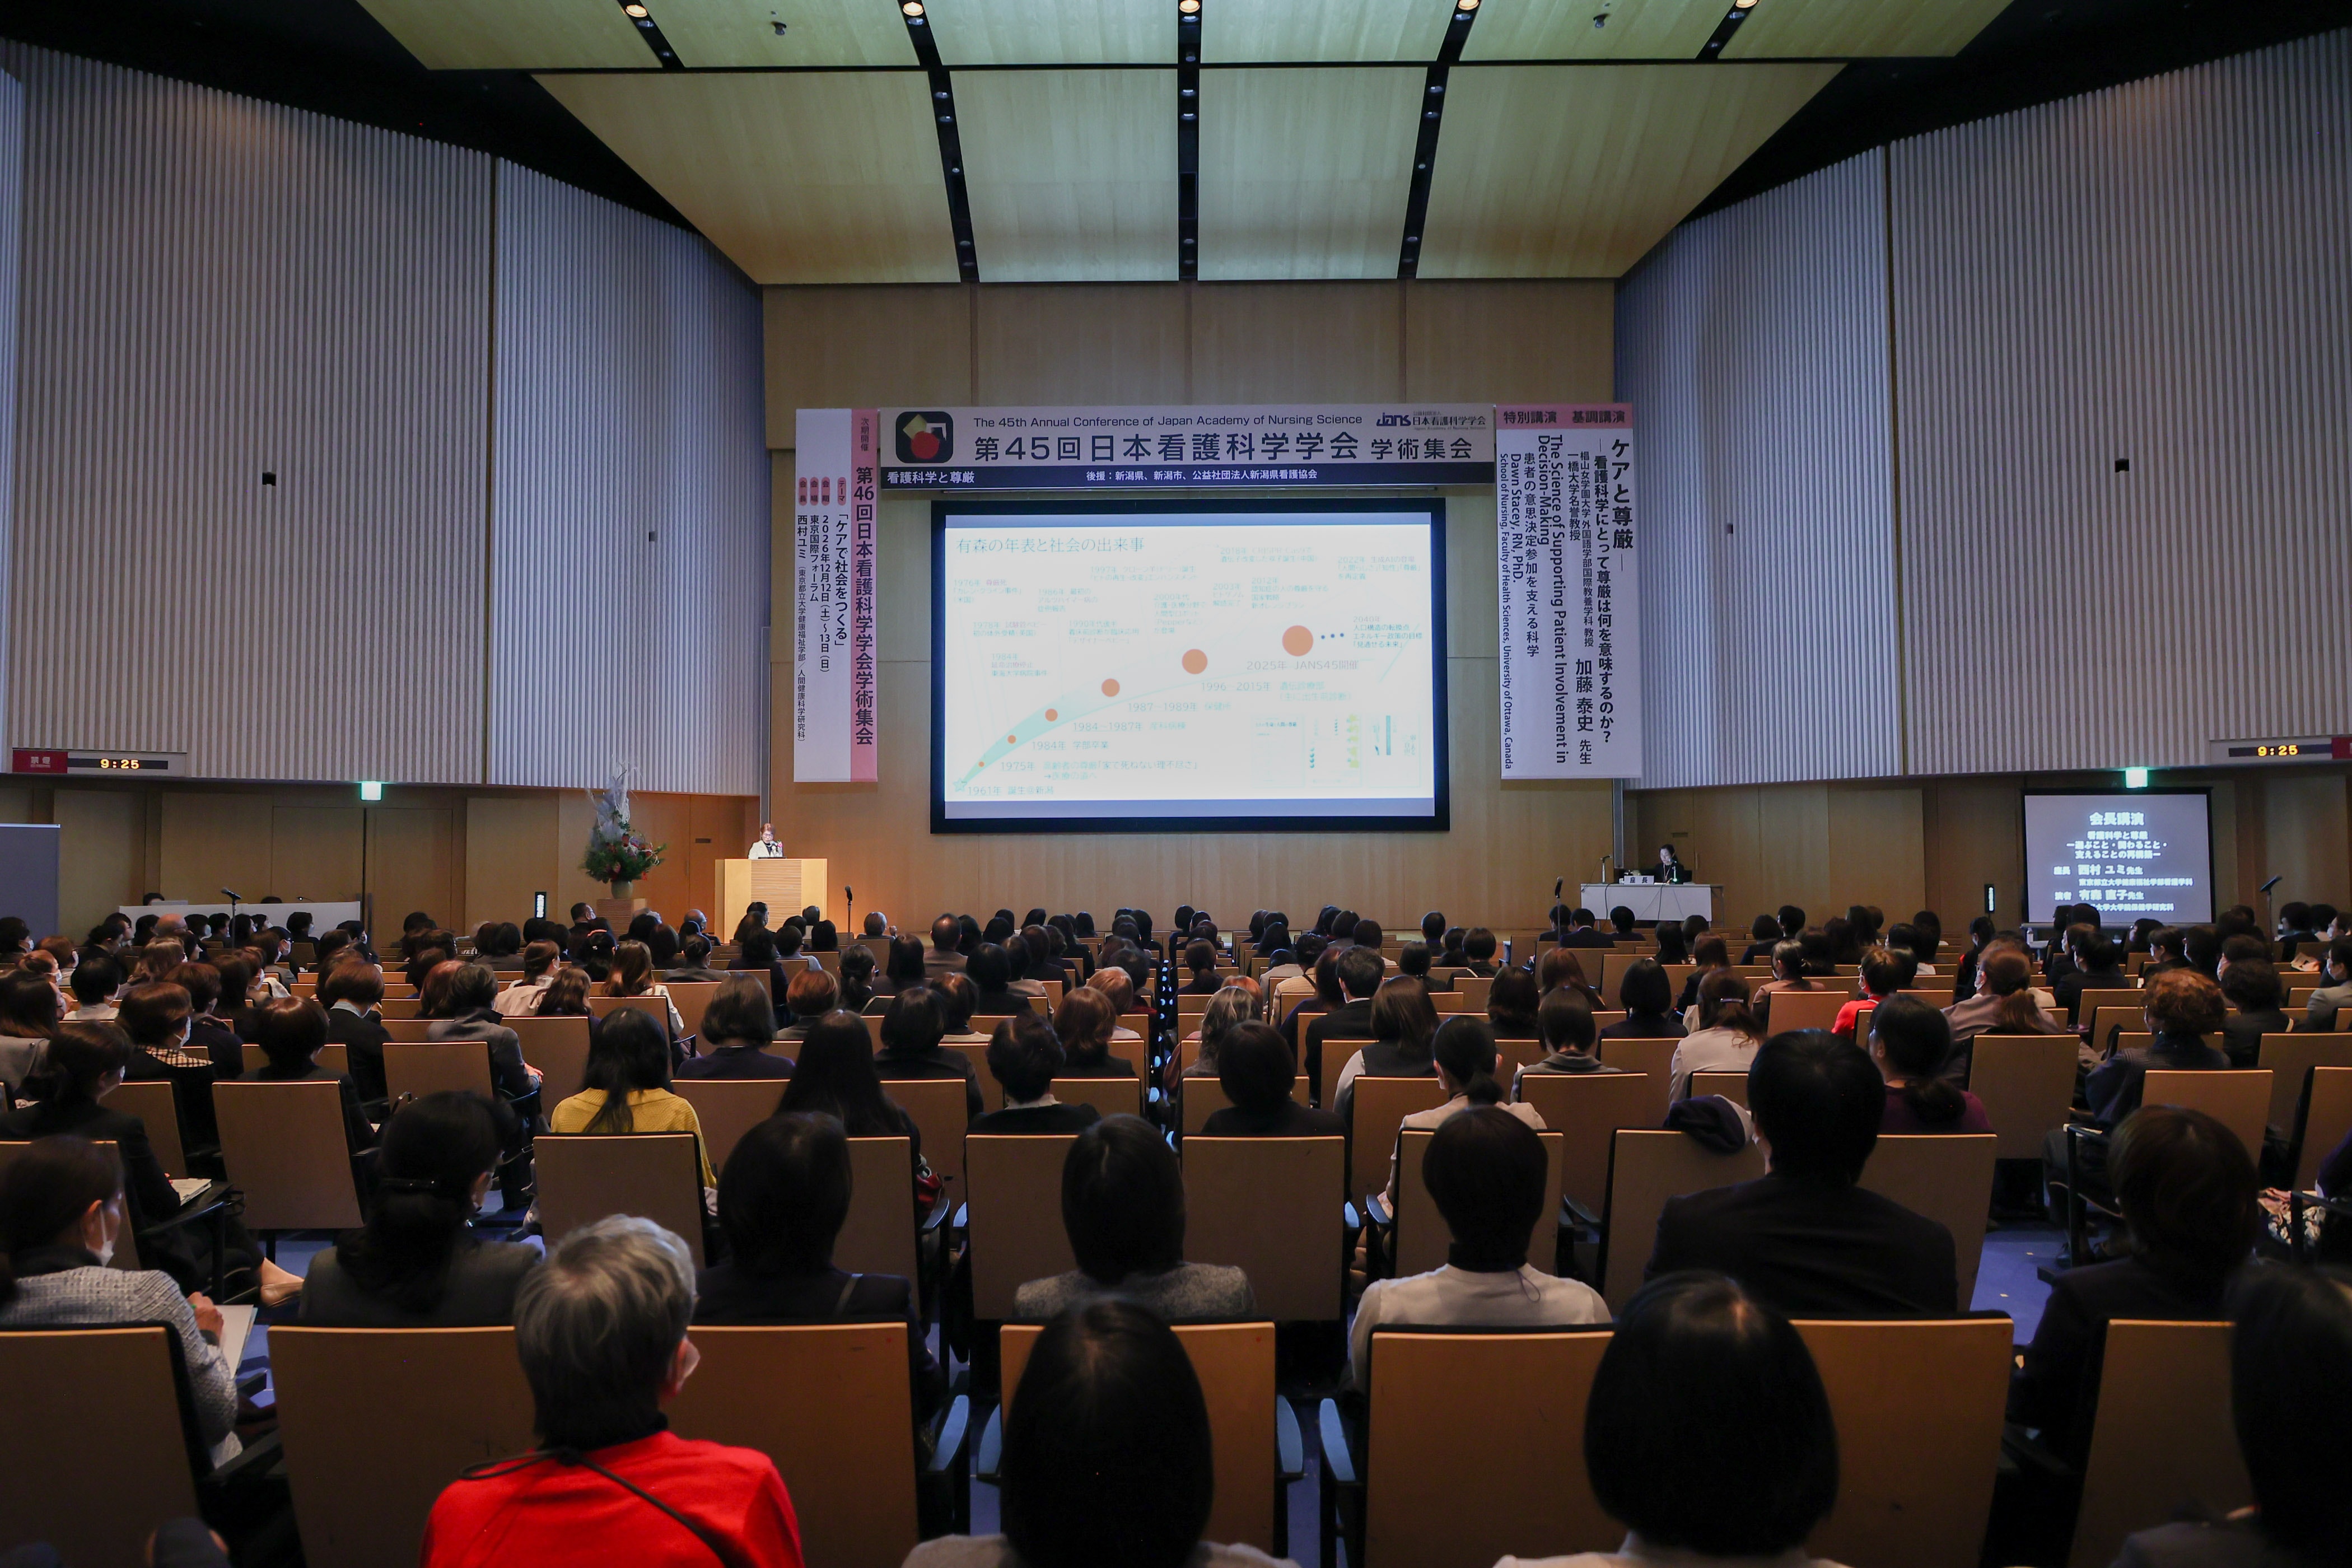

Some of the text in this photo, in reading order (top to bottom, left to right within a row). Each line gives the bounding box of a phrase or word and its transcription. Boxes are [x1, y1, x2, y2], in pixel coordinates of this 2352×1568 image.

[974, 414, 1362, 427] The 45th Annual Conference of Japan Academy of Nursing Science
[1413, 416, 1486, 426] 日本看護科学学会
[1504, 410, 1625, 424] 特別講演 基調講演
[861, 418, 869, 451] 次期開催
[974, 432, 1472, 461] 第45回日本看護科学学会 学術集会
[1500, 454, 1509, 479] School
[887, 471, 974, 484] 看護科学と尊厳
[1501, 483, 1509, 492] of
[1537, 436, 1551, 545] Decision-Making
[1568, 454, 1581, 541] 一橋大学名誉教授
[1500, 494, 1509, 530] Nursing,
[1509, 454, 1523, 583] Dawn Stacey, RN, PhD.
[797, 514, 808, 559] 西村ユミ
[956, 537, 1145, 554] 有森の年表と社会の出来事
[1500, 532, 1509, 561] Faculty
[1524, 452, 1539, 657] 患者の意思決定参加を支える科学
[810, 514, 819, 602] 東京国際フォーラム
[1091, 565, 1116, 573] 1997年
[1502, 564, 1510, 573] of
[834, 514, 848, 646] 「ケアで社会をつくる」
[854, 466, 875, 745] 第46回日本看護科学学会学術集会
[1550, 435, 1569, 763] The Science of Supporting Patient Involvement in
[1502, 605, 1511, 643] Sciences,
[1584, 628, 1594, 647] 教授
[1247, 660, 1359, 670] 2025年 JANS45開催
[1502, 646, 1511, 688] University
[1280, 681, 1325, 690] 遺伝診療部
[1504, 701, 1512, 735] Ottawa,
[1575, 659, 1593, 764] 加藤 泰史 先生
[1032, 740, 1109, 750] 1984年 学部卒業
[1504, 737, 1513, 769] Canada
[2257, 745, 2298, 757] 9:25
[100, 759, 139, 769] 9:25
[1000, 761, 1035, 771] 1975年
[967, 786, 1002, 796] 1961年
[2089, 812, 2145, 826] 会長講演
[2087, 830, 2148, 840] 看護科学と尊厳
[2078, 864, 2101, 875] 西村
[2079, 889, 2102, 900] 有森
